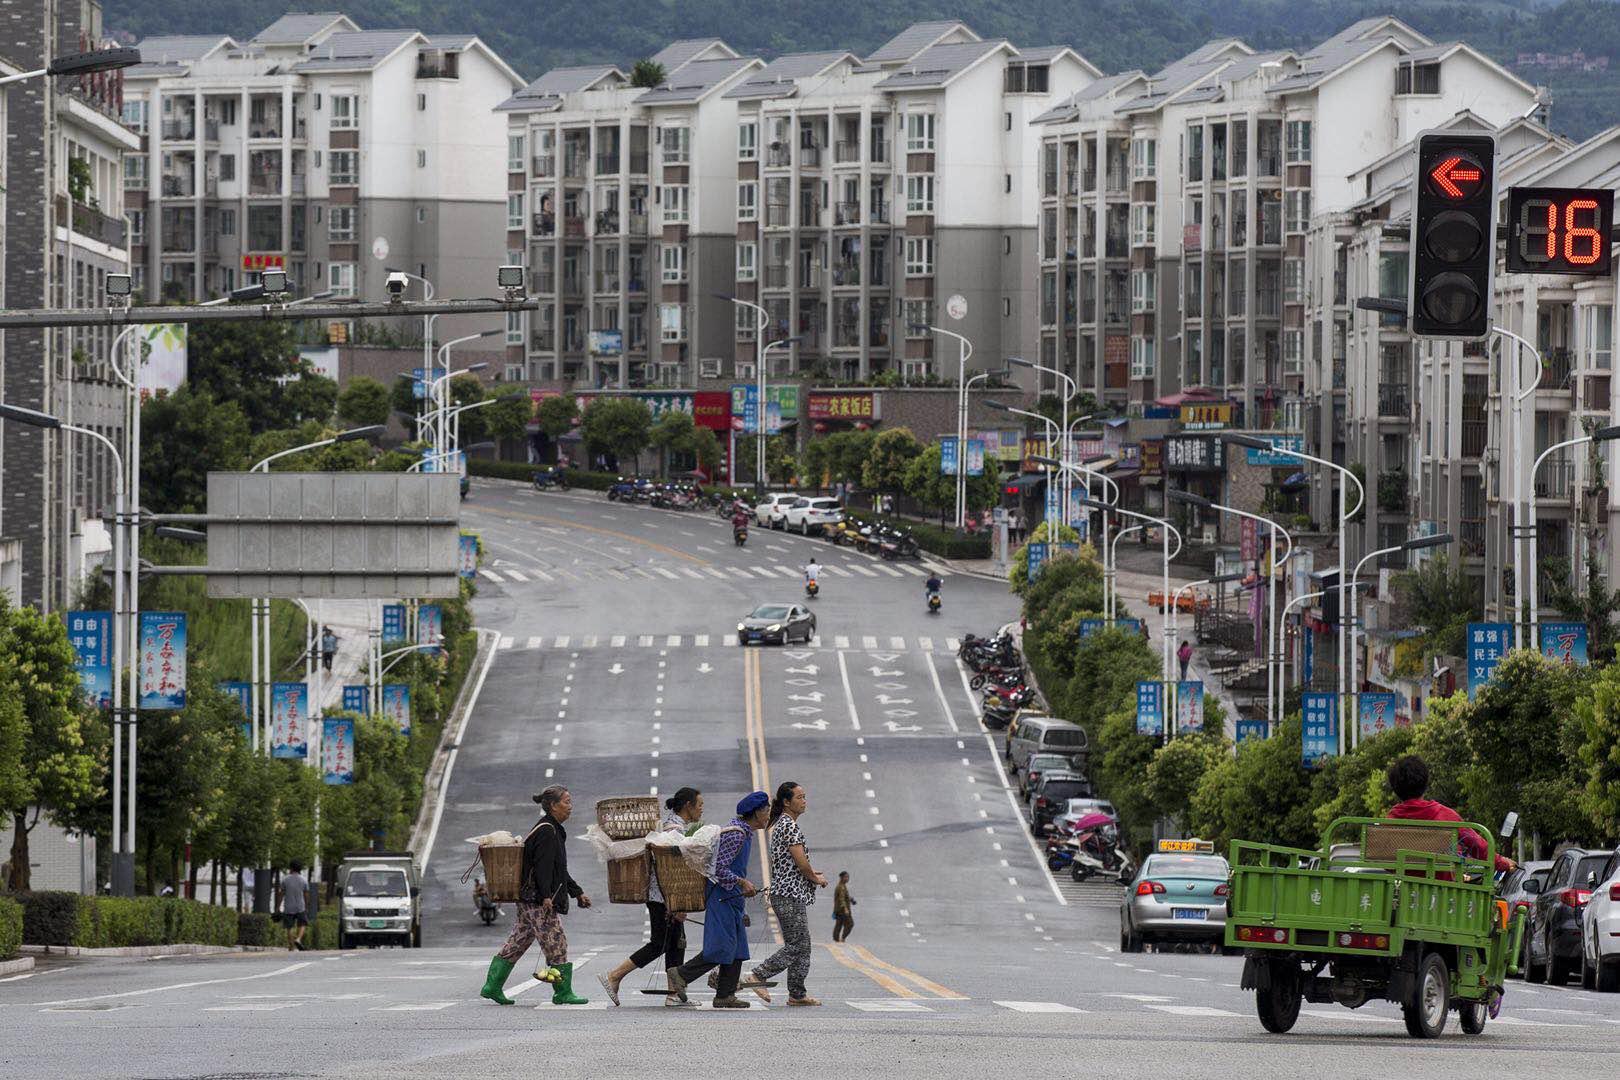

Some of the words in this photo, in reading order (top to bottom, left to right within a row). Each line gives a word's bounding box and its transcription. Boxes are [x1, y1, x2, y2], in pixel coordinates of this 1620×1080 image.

[1547, 200, 1601, 264] 16
[830, 397, 872, 416] 农家饭店
[74, 618, 97, 631] 自由
[73, 636, 97, 649] 平等
[1474, 630, 1498, 643] 富强
[1474, 648, 1498, 660] 民主
[1307, 698, 1326, 708] 爱国
[1307, 713, 1326, 722] 敬业
[1307, 727, 1326, 737] 诚信
[1307, 741, 1326, 751] 友善
